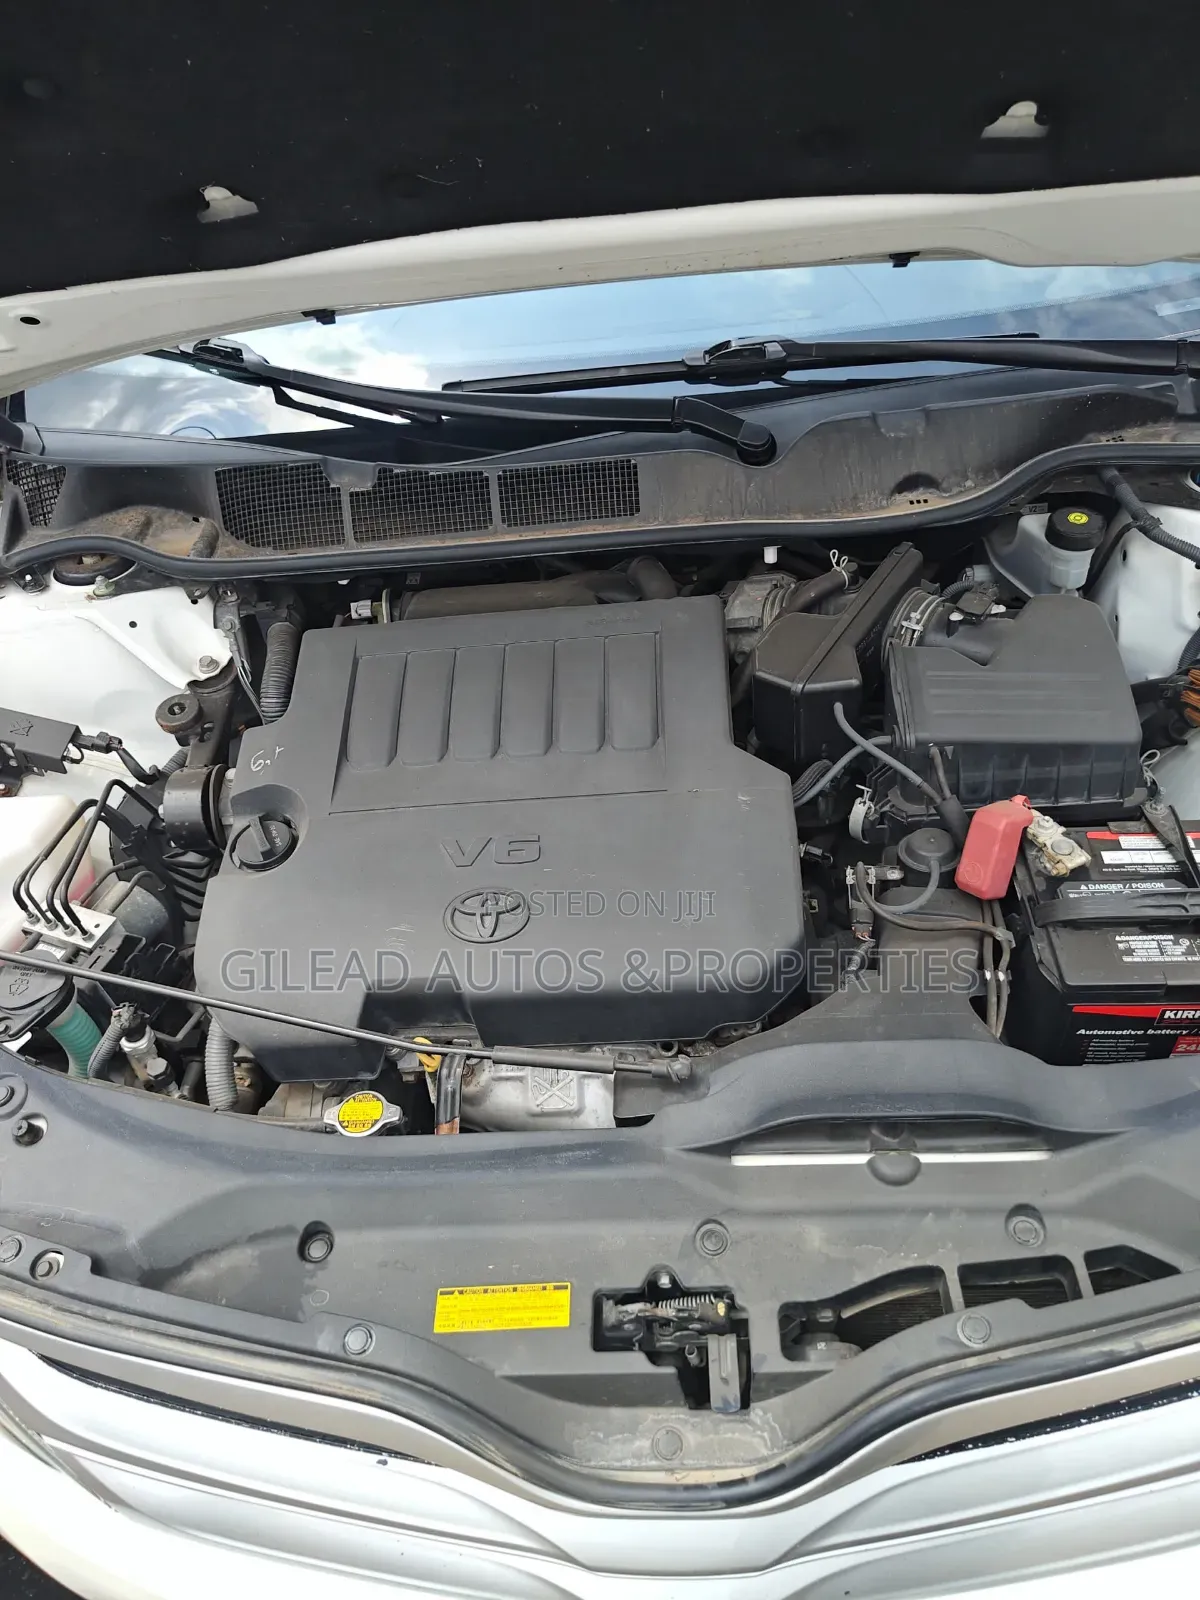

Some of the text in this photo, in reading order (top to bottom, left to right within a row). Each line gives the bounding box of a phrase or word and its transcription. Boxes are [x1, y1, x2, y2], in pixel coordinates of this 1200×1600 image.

[440, 834, 541, 867] V6
[1089, 882, 1123, 890] DANGER
[1146, 1028, 1189, 1036] battery
